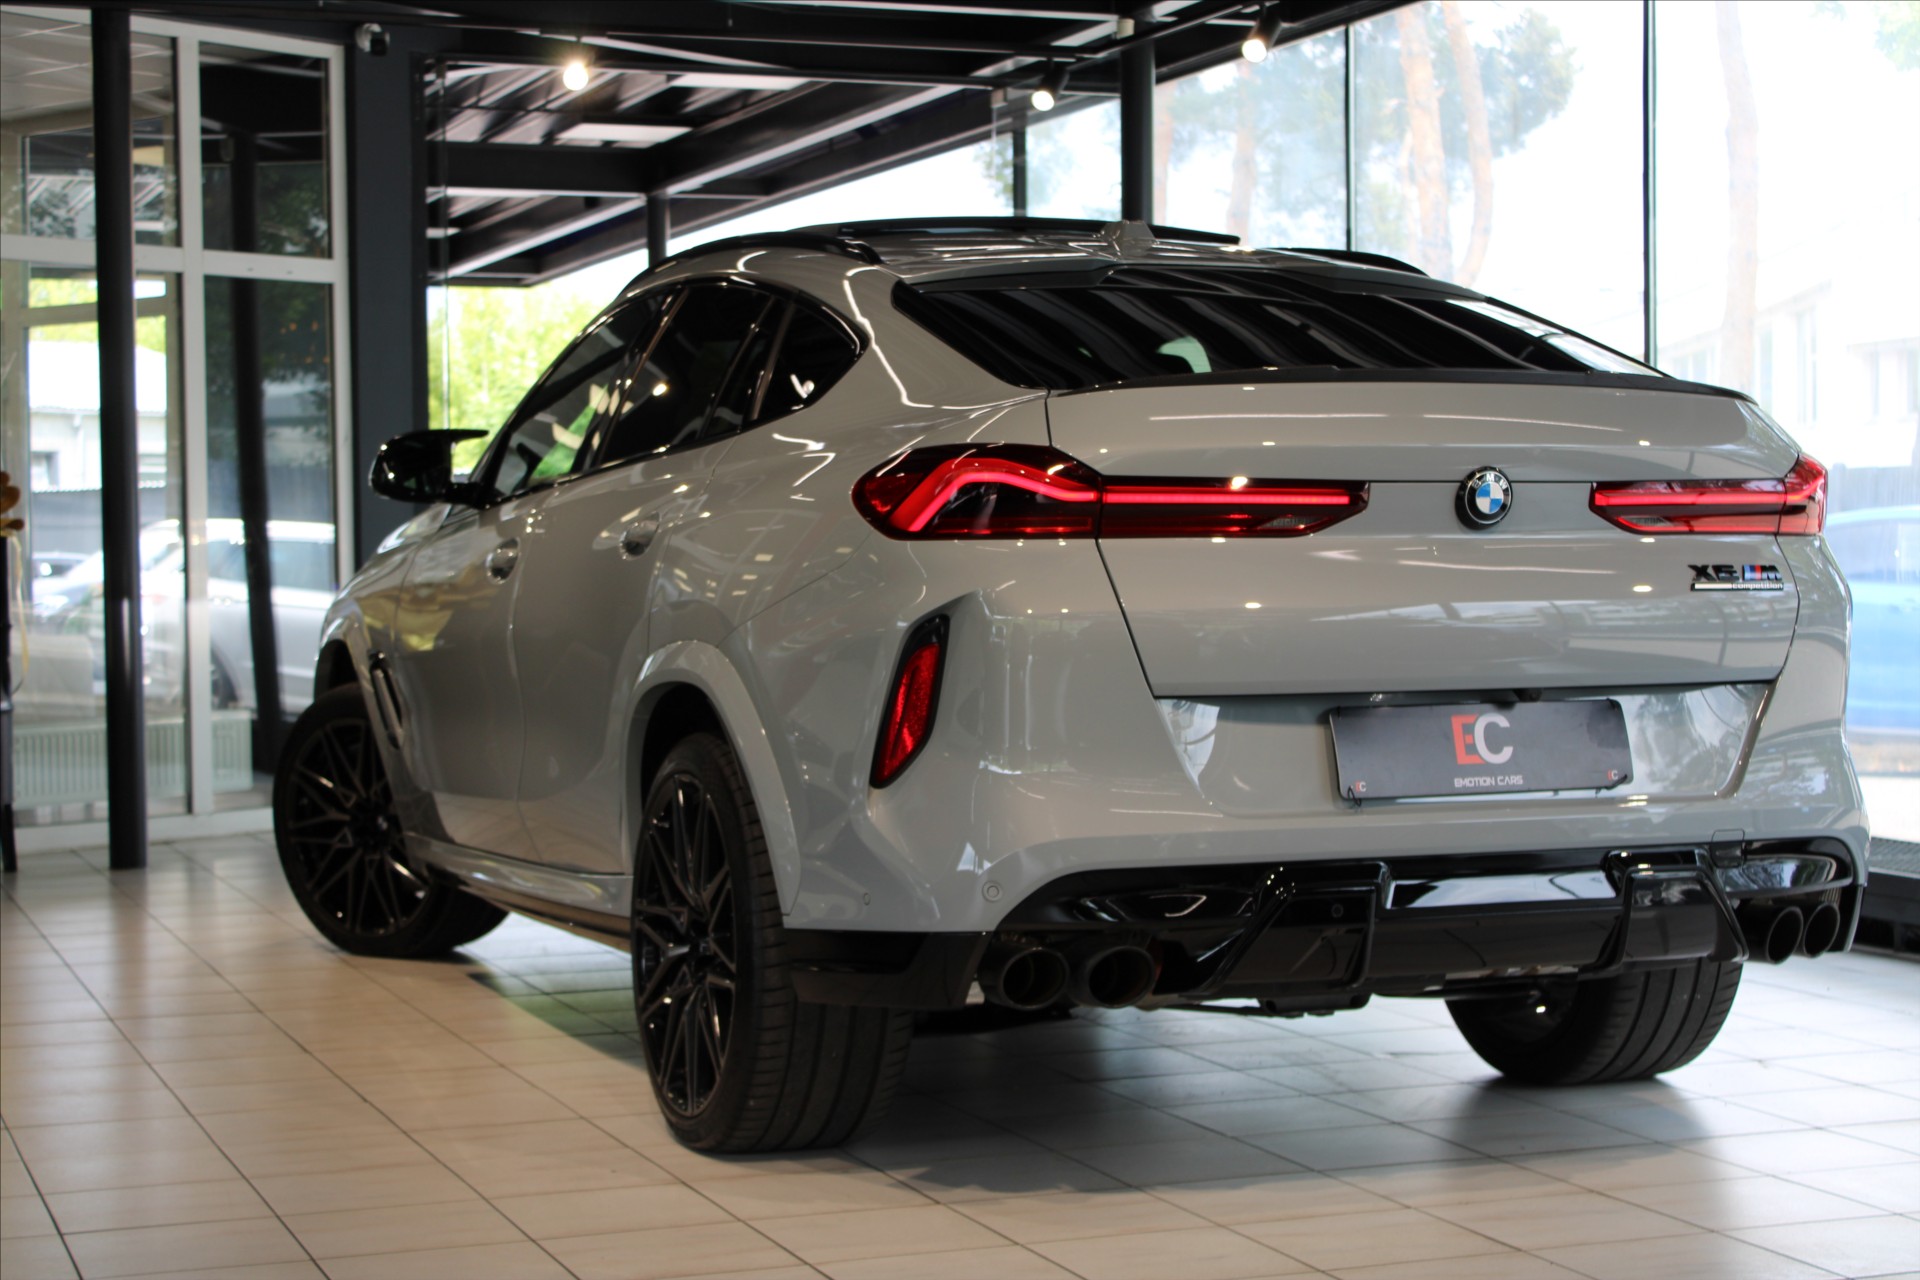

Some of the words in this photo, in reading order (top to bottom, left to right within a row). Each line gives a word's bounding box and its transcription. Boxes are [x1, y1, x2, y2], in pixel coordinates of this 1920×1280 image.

[1472, 473, 1509, 489] BMW
[1451, 712, 1514, 765] EC
[1454, 776, 1495, 788] EMOTION
[1497, 774, 1524, 786] CARS
